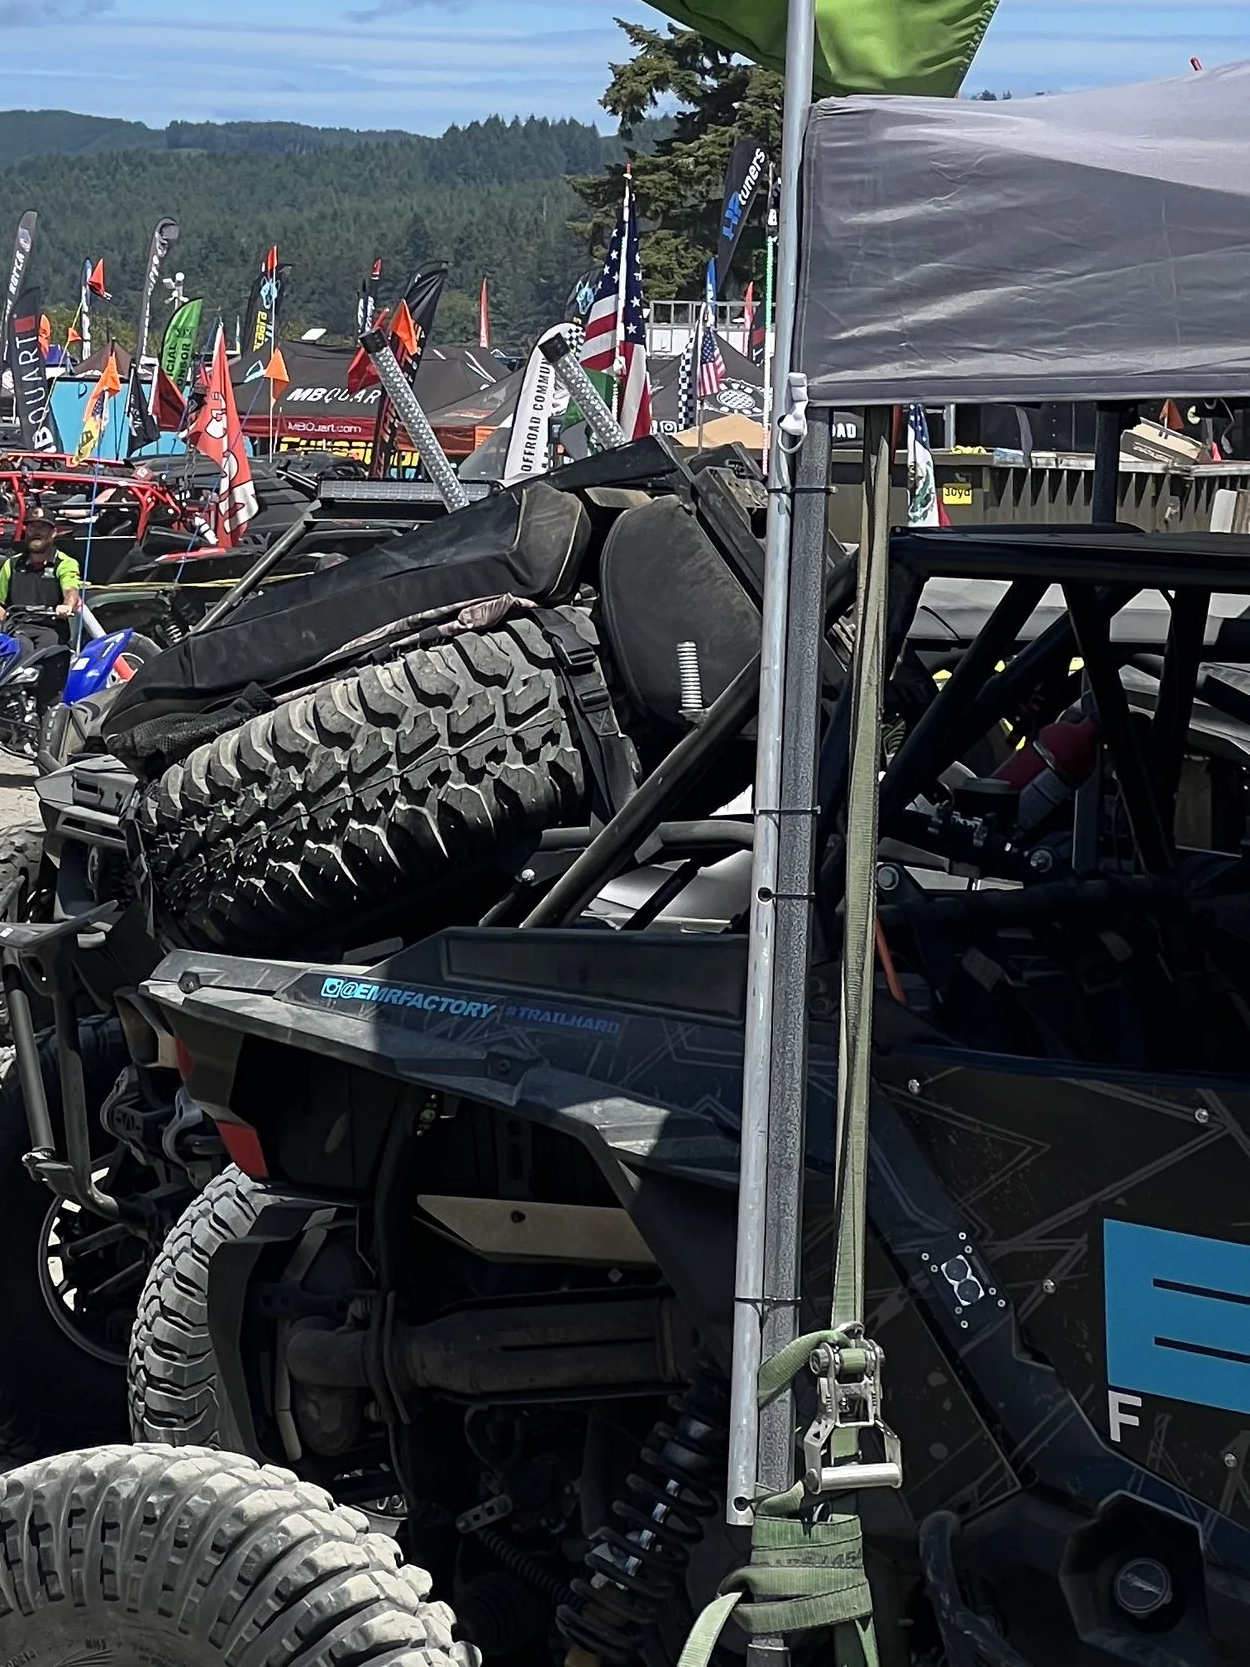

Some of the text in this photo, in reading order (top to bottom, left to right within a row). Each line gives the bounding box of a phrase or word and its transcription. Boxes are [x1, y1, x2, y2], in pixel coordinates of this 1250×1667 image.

[177, 342, 192, 387] ONSOR
[286, 387, 382, 405] MBQUAR
[520, 416, 543, 473] OFFROAD
[341, 981, 620, 1034] @EMRFACTORY #TRAILHARD
